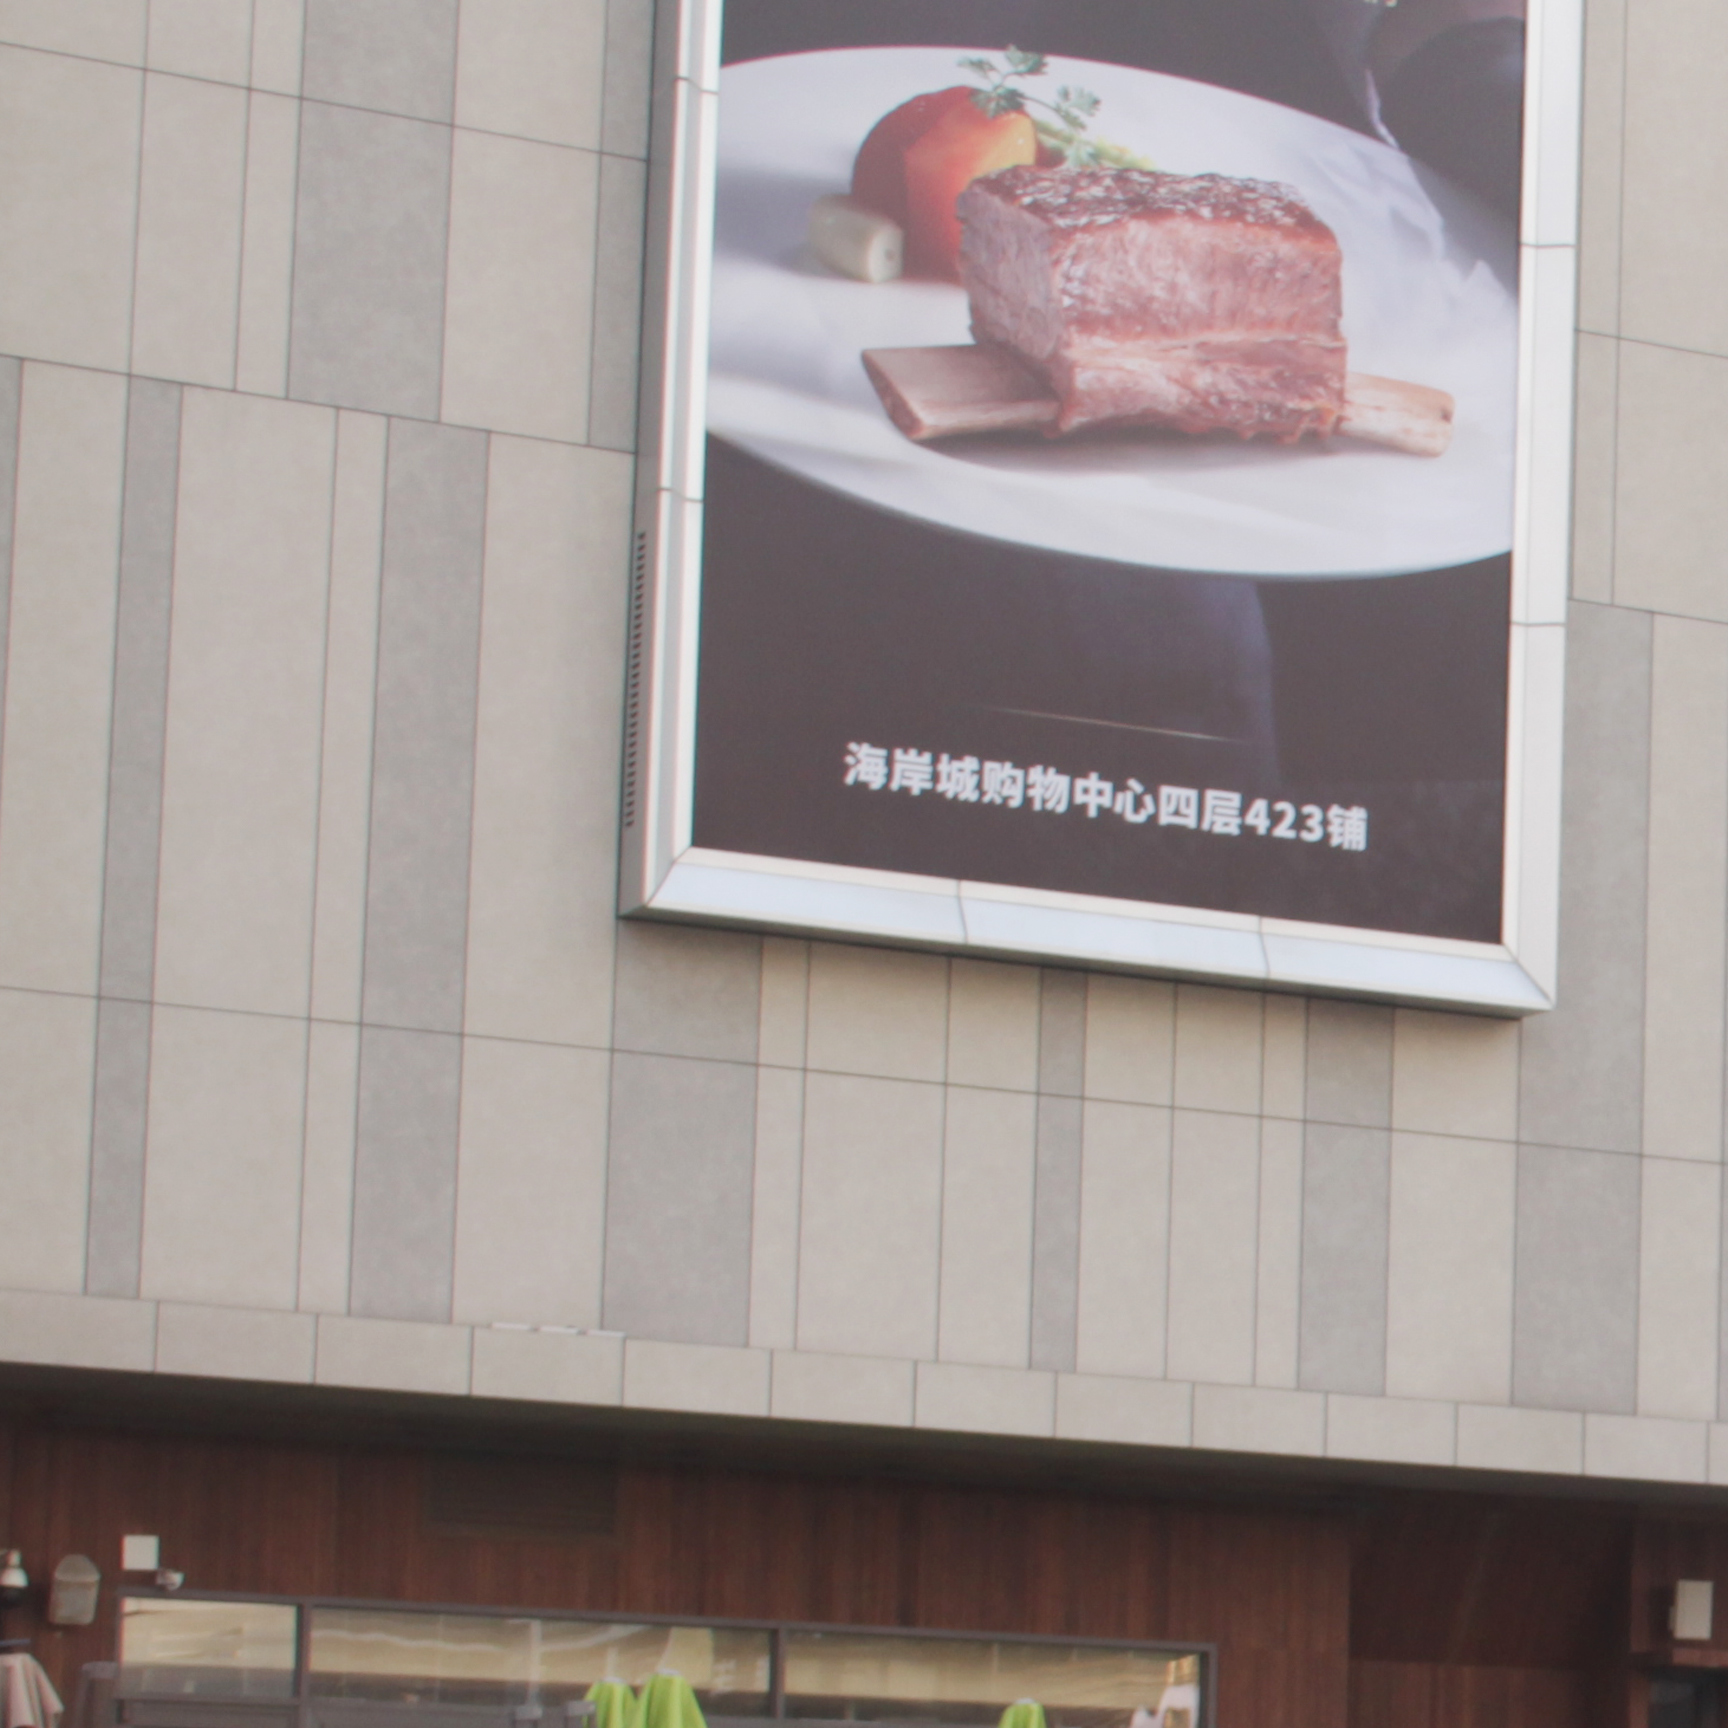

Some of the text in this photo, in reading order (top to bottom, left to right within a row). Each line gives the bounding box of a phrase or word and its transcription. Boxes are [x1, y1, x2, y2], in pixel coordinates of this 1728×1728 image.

[843, 740, 1369, 852] 海岸城购物中心四层423铺
